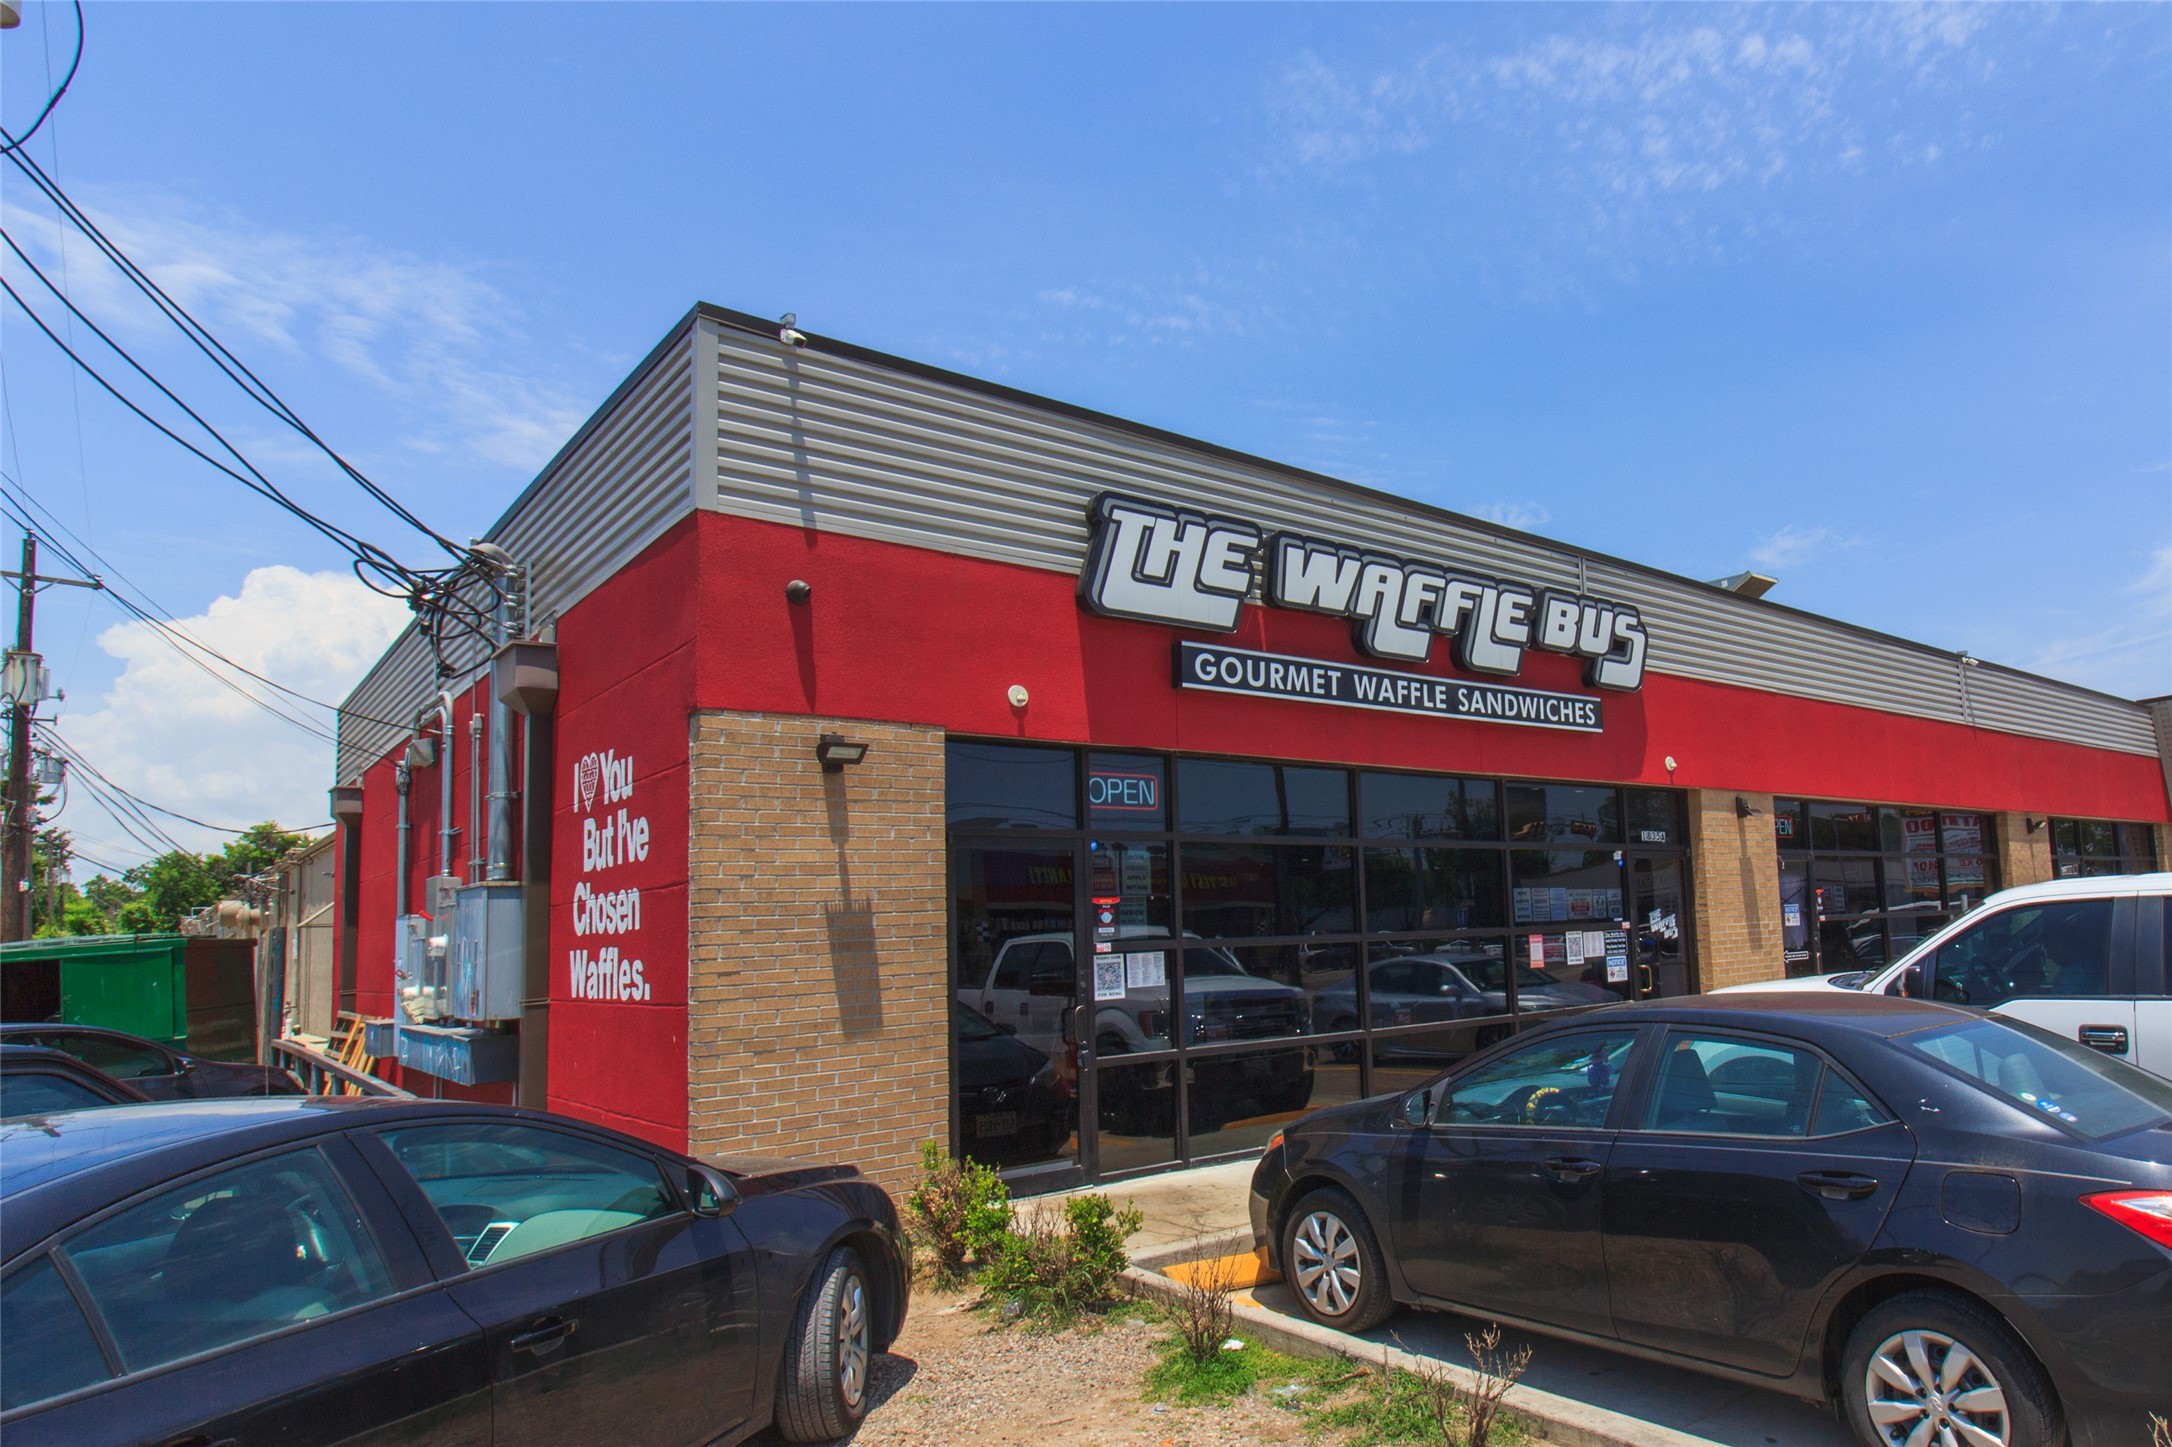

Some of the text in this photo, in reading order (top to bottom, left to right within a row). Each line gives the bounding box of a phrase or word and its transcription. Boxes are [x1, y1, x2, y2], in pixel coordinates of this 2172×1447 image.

[1096, 500, 1649, 692] THE WAFFLE BUS
[1194, 652, 1597, 726] GOURMET WAFFLE SANDWICHES
[573, 748, 634, 814] I You
[1089, 776, 1155, 805] OPEN
[583, 807, 650, 873] But I've
[1775, 817, 1792, 835] PEN
[573, 881, 641, 937] Chosen
[569, 946, 651, 1002] Waffles.
[1608, 958, 1625, 966] NOTICE
